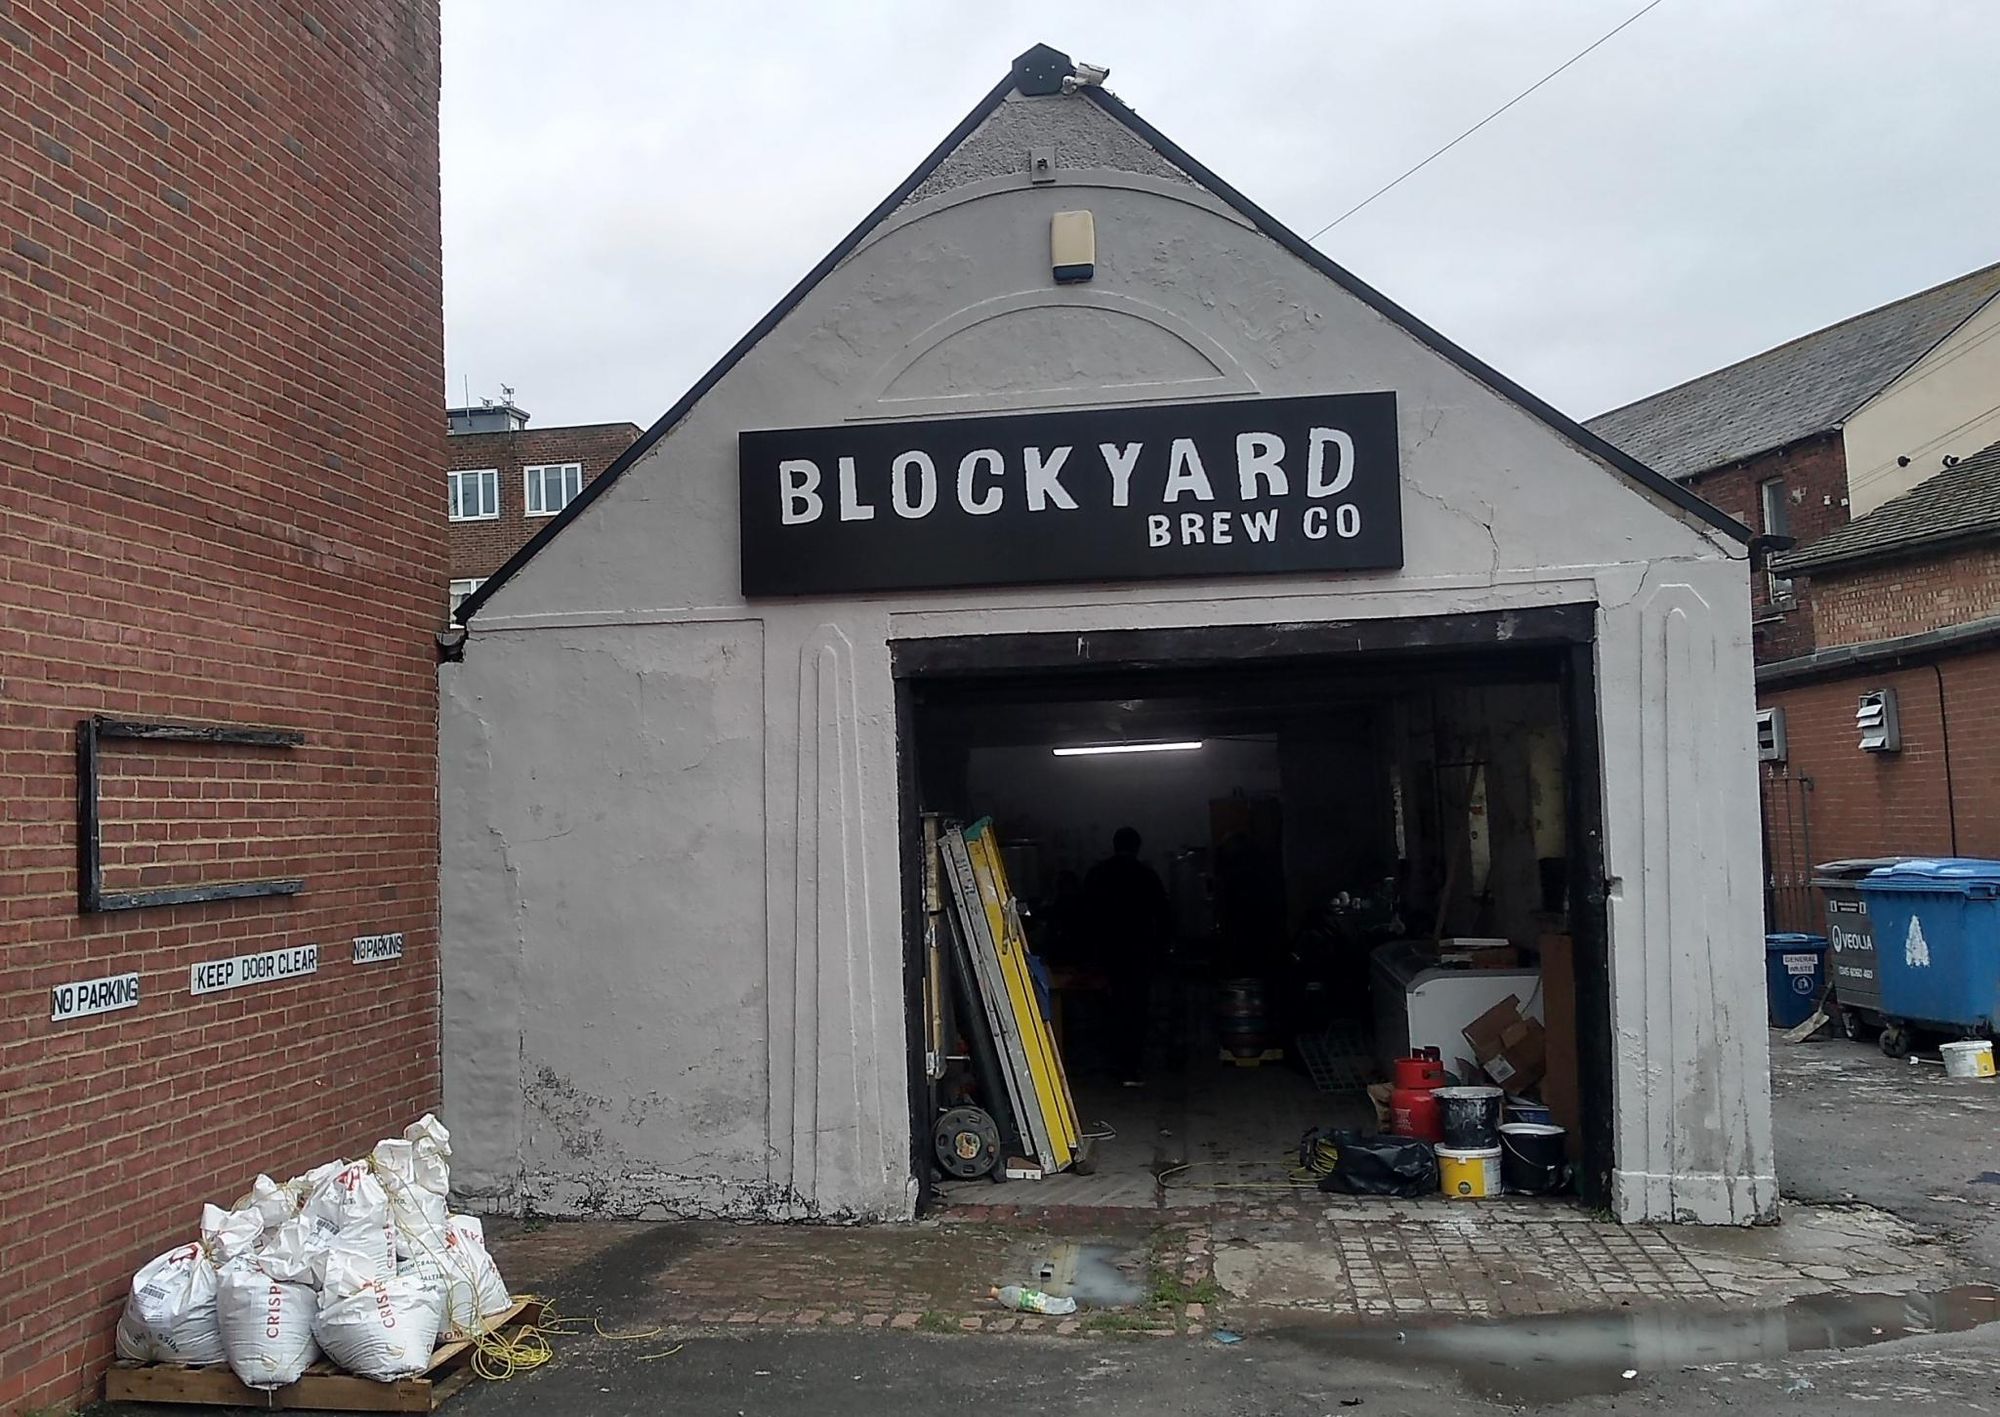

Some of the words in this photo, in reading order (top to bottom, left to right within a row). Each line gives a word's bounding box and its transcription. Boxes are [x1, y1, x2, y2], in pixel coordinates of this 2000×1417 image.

[779, 427, 1355, 526] BLOCKYARD
[1148, 508, 1279, 548] BREW
[1303, 503, 1361, 541] CO
[353, 940, 366, 960] NO
[366, 935, 403, 958] PARKING
[1842, 933, 1873, 950] VEOLIA
[197, 961, 234, 990] KEEP
[242, 955, 275, 981] DOOR
[278, 948, 317, 975] CLEAR
[52, 987, 74, 1016] NO
[77, 977, 138, 1011] PARKING
[266, 1285, 282, 1339] CRISP
